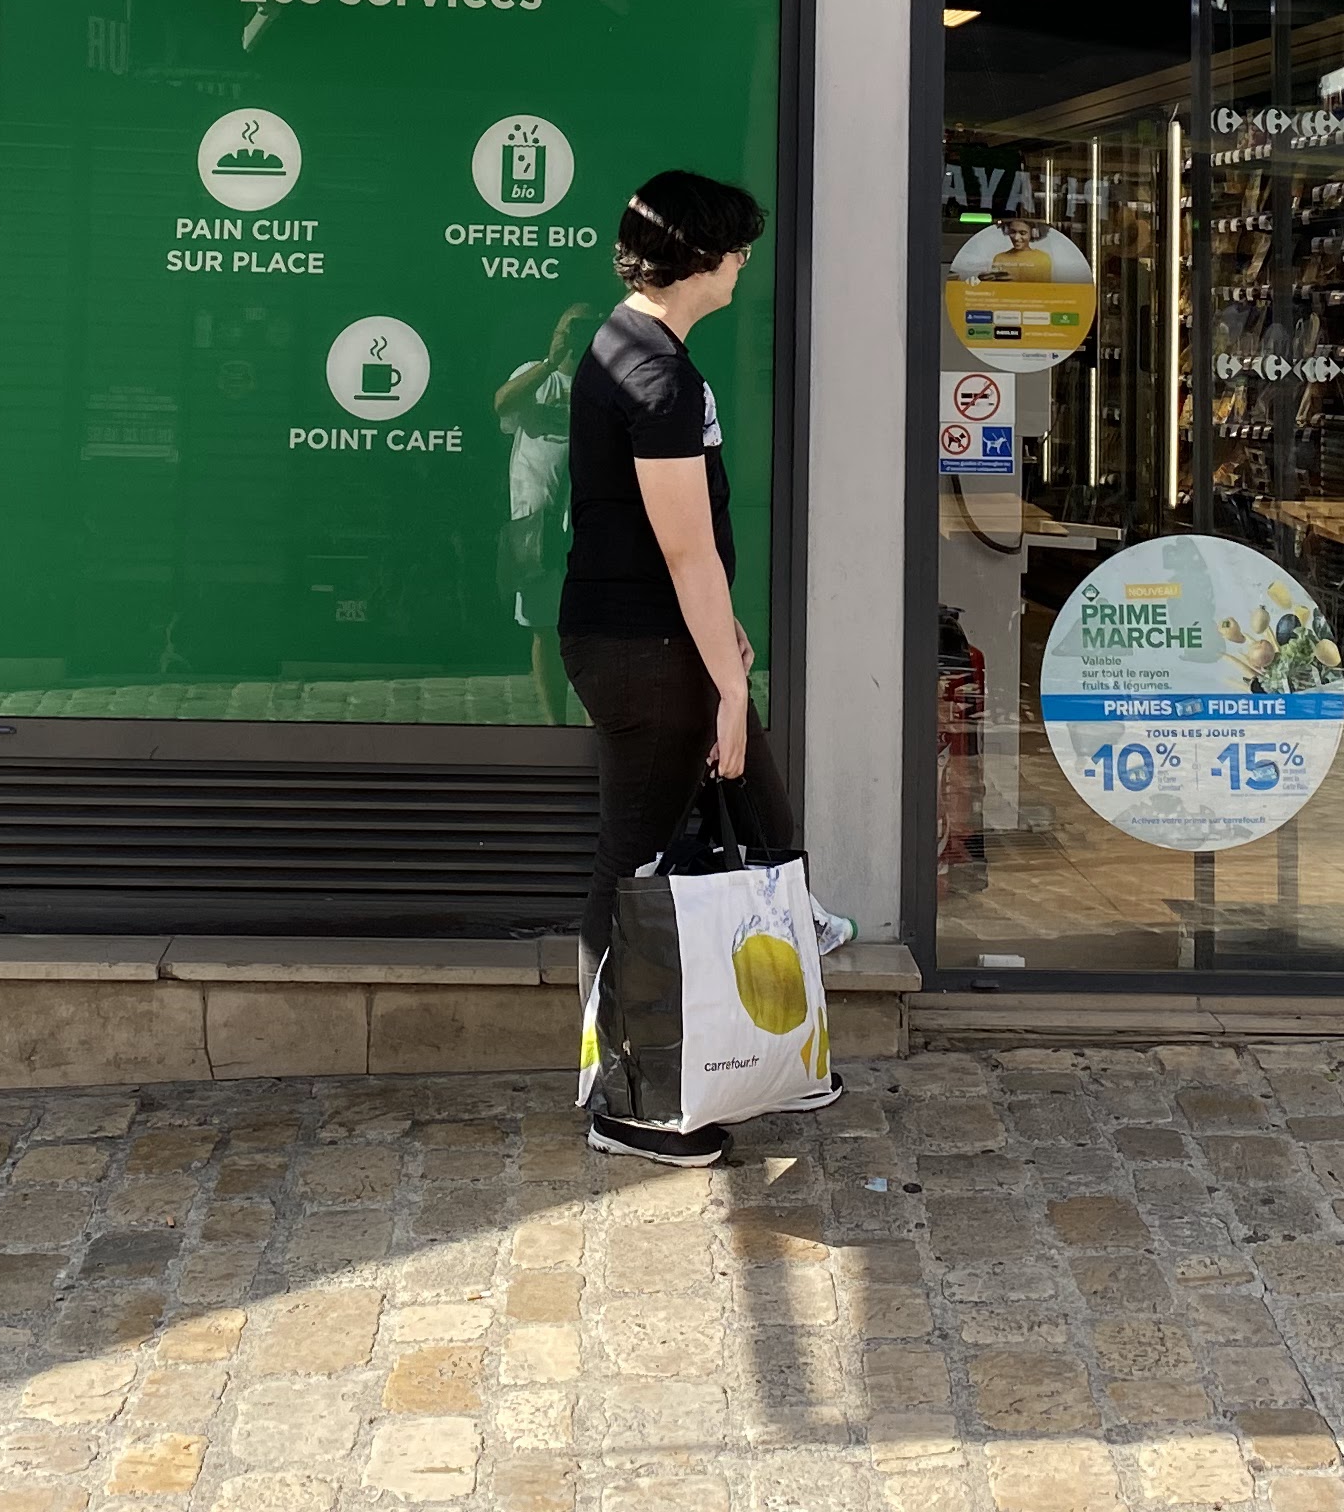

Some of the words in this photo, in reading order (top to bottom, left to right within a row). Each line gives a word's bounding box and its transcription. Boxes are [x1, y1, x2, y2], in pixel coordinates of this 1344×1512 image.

[511, 184, 535, 199] bio
[175, 218, 245, 241] PAIN
[252, 219, 318, 241] CUIT
[444, 224, 541, 248] OFFRE
[548, 226, 598, 249] BIO
[167, 250, 226, 272] SUR
[231, 251, 324, 274] PLACE
[482, 256, 560, 280] VRAC
[289, 427, 379, 452] POINT
[386, 425, 463, 453] CAFÉ
[1128, 586, 1178, 598] NOUVEAU
[1081, 603, 1167, 625] PRIME
[1081, 621, 1202, 648] MARCHÉ
[1081, 656, 1121, 666] Valable
[1082, 670, 1099, 678] sur
[1102, 669, 1123, 678] tout
[1126, 669, 1136, 678] le
[1139, 670, 1169, 680] rayon
[1082, 681, 1109, 691] fruits
[1112, 681, 1121, 691] &
[1123, 680, 1172, 693] légumes.
[1104, 699, 1172, 717] PRIMES
[1208, 696, 1286, 716] FIDÉLITÉ
[1146, 729, 1178, 738] TOUS
[1181, 729, 1202, 738] LES
[1205, 729, 1246, 738] JOURS
[704, 1054, 760, 1072] carrefour.fr
